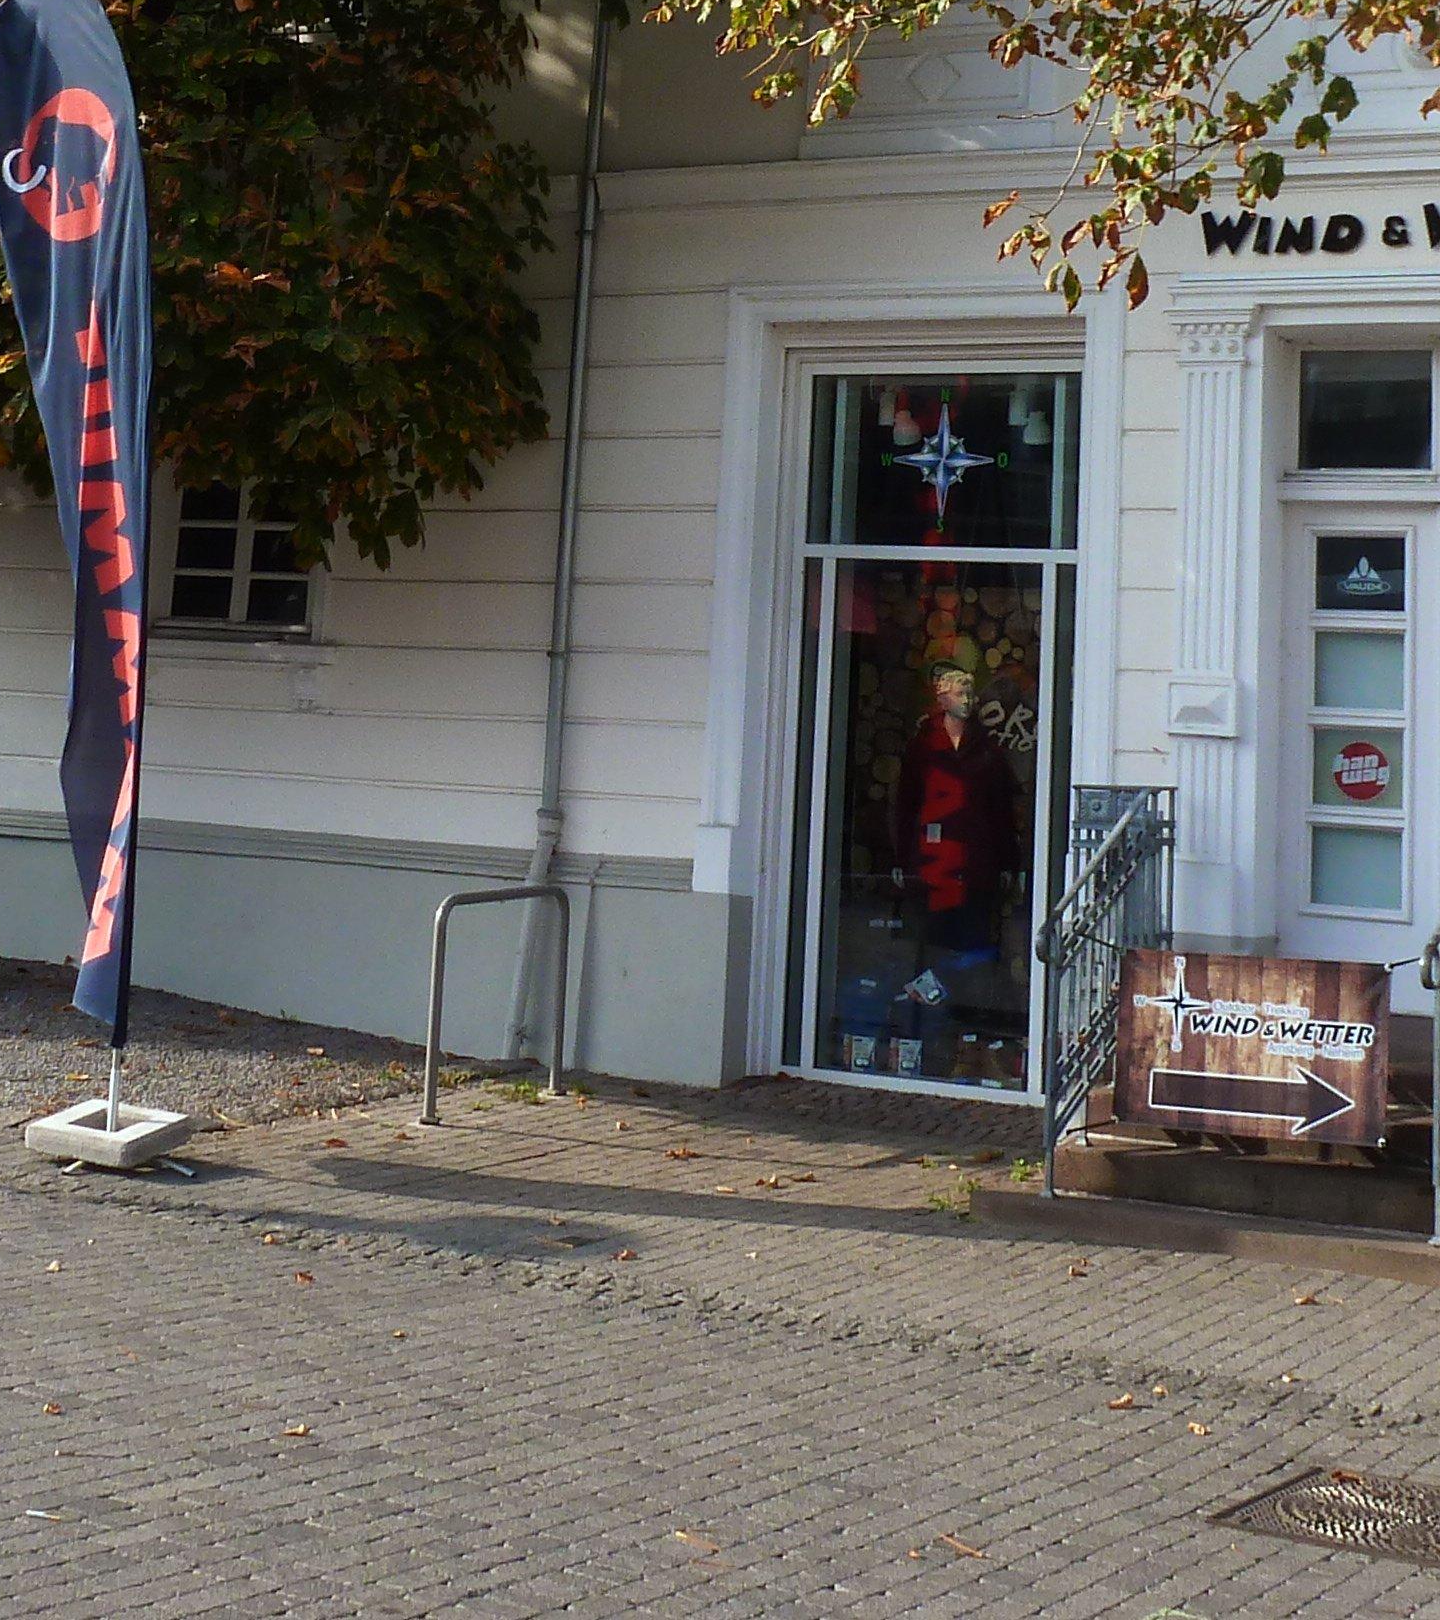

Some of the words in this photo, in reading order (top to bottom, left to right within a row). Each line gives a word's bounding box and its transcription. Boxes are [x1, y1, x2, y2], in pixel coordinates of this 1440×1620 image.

[1201, 210, 1365, 255] WIND
[1382, 216, 1410, 246] &
[1191, 1014, 1260, 1036] WIND
[1263, 1023, 1274, 1036] &
[1280, 1021, 1375, 1045] WETTER
